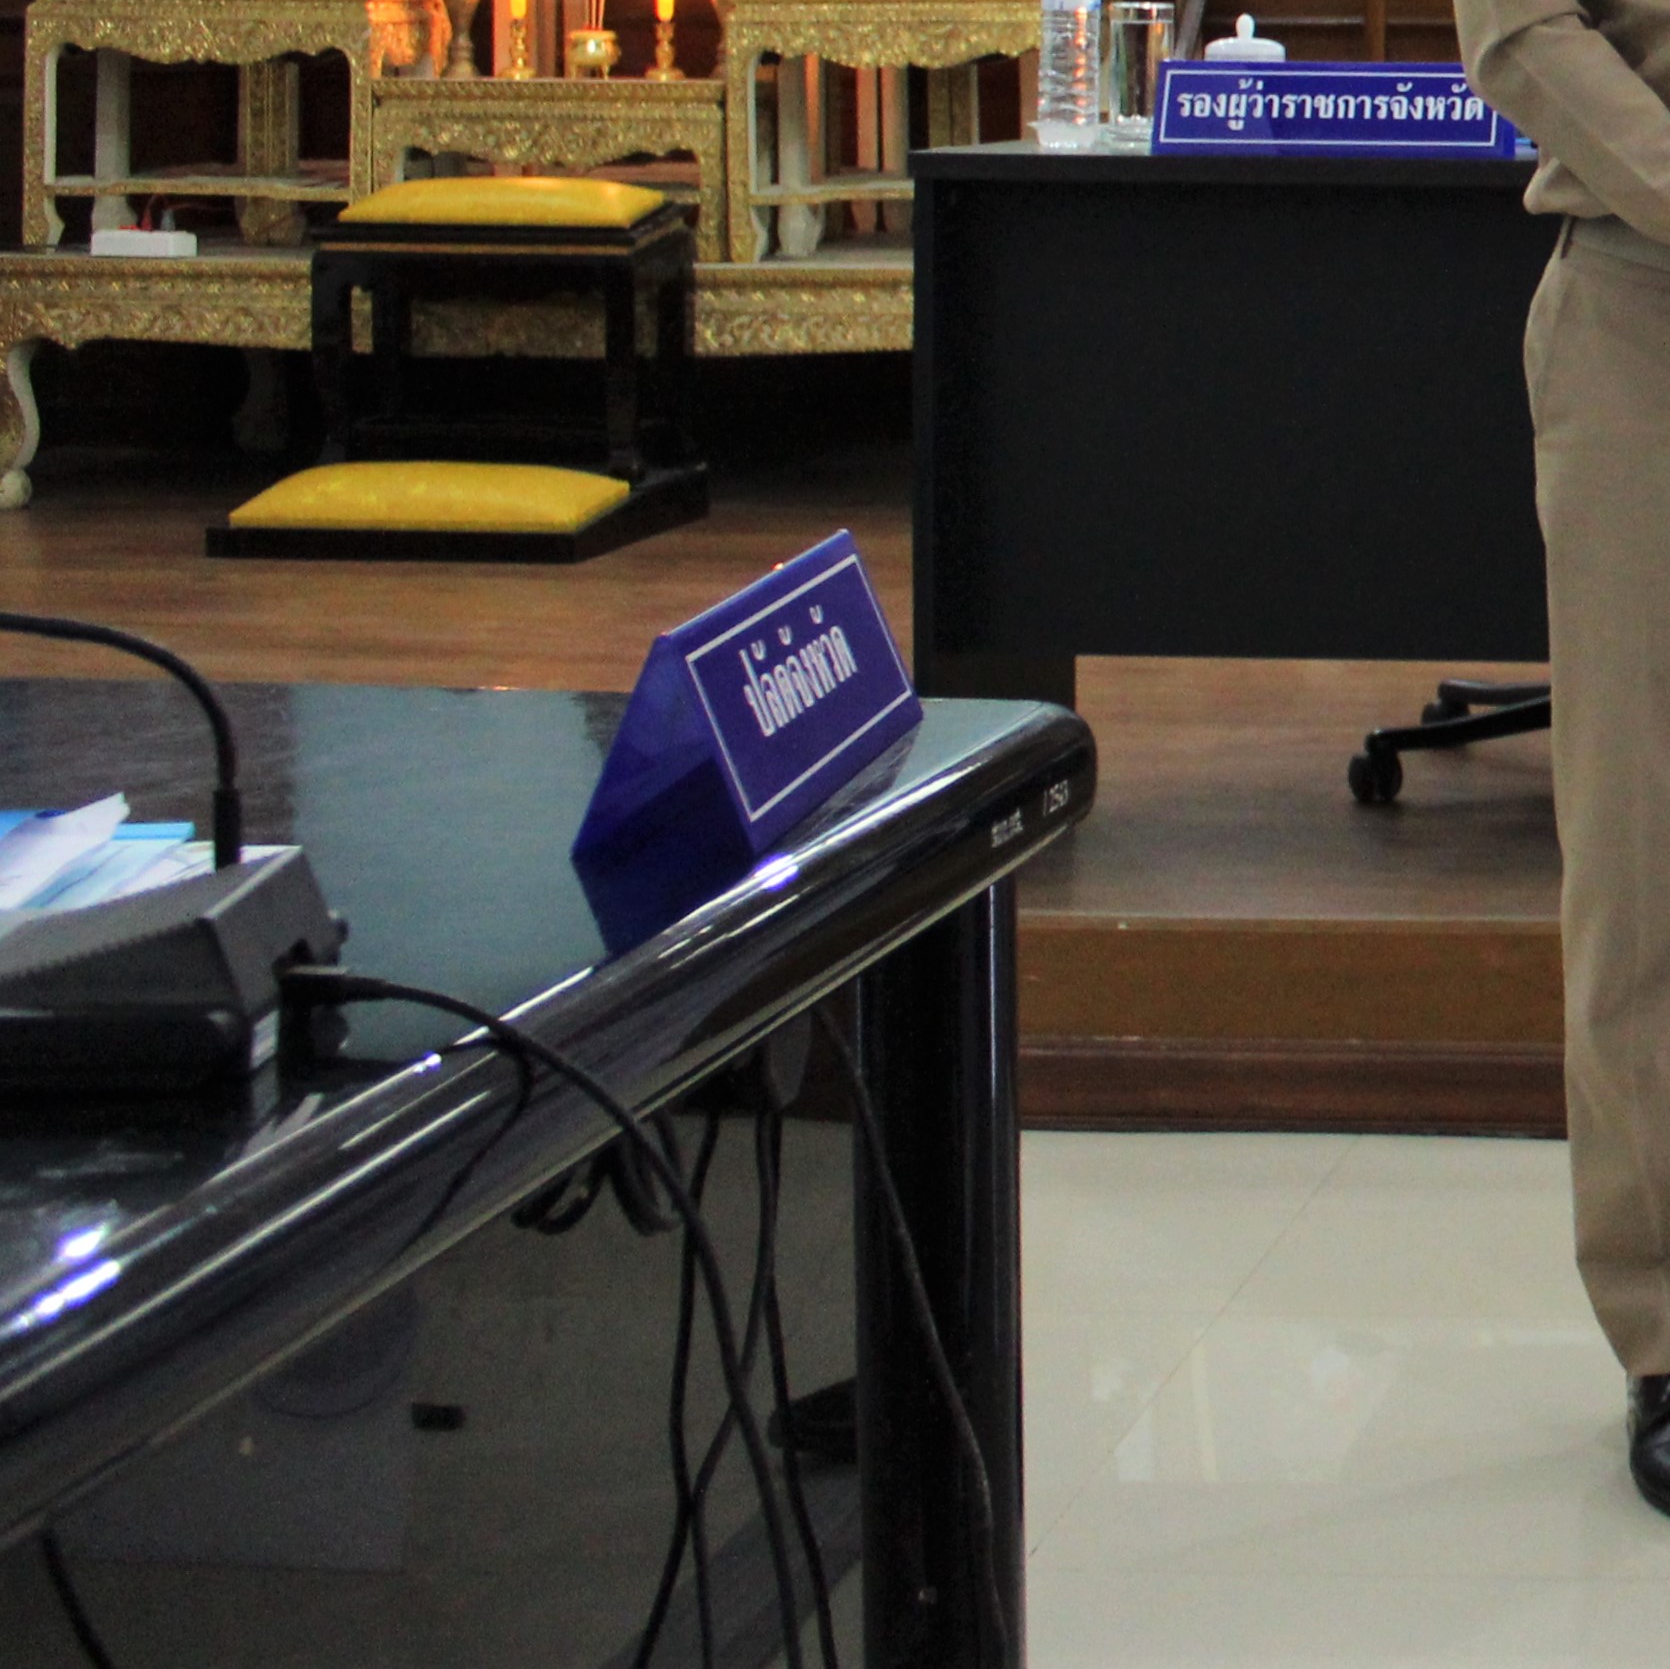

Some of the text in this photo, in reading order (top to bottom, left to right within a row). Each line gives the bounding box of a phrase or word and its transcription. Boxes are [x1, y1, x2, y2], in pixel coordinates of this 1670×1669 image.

[1177, 78, 1485, 131] รองผู้ว่าราชการจังหวัด
[738, 604, 858, 737] ปลัดจังหวัด
